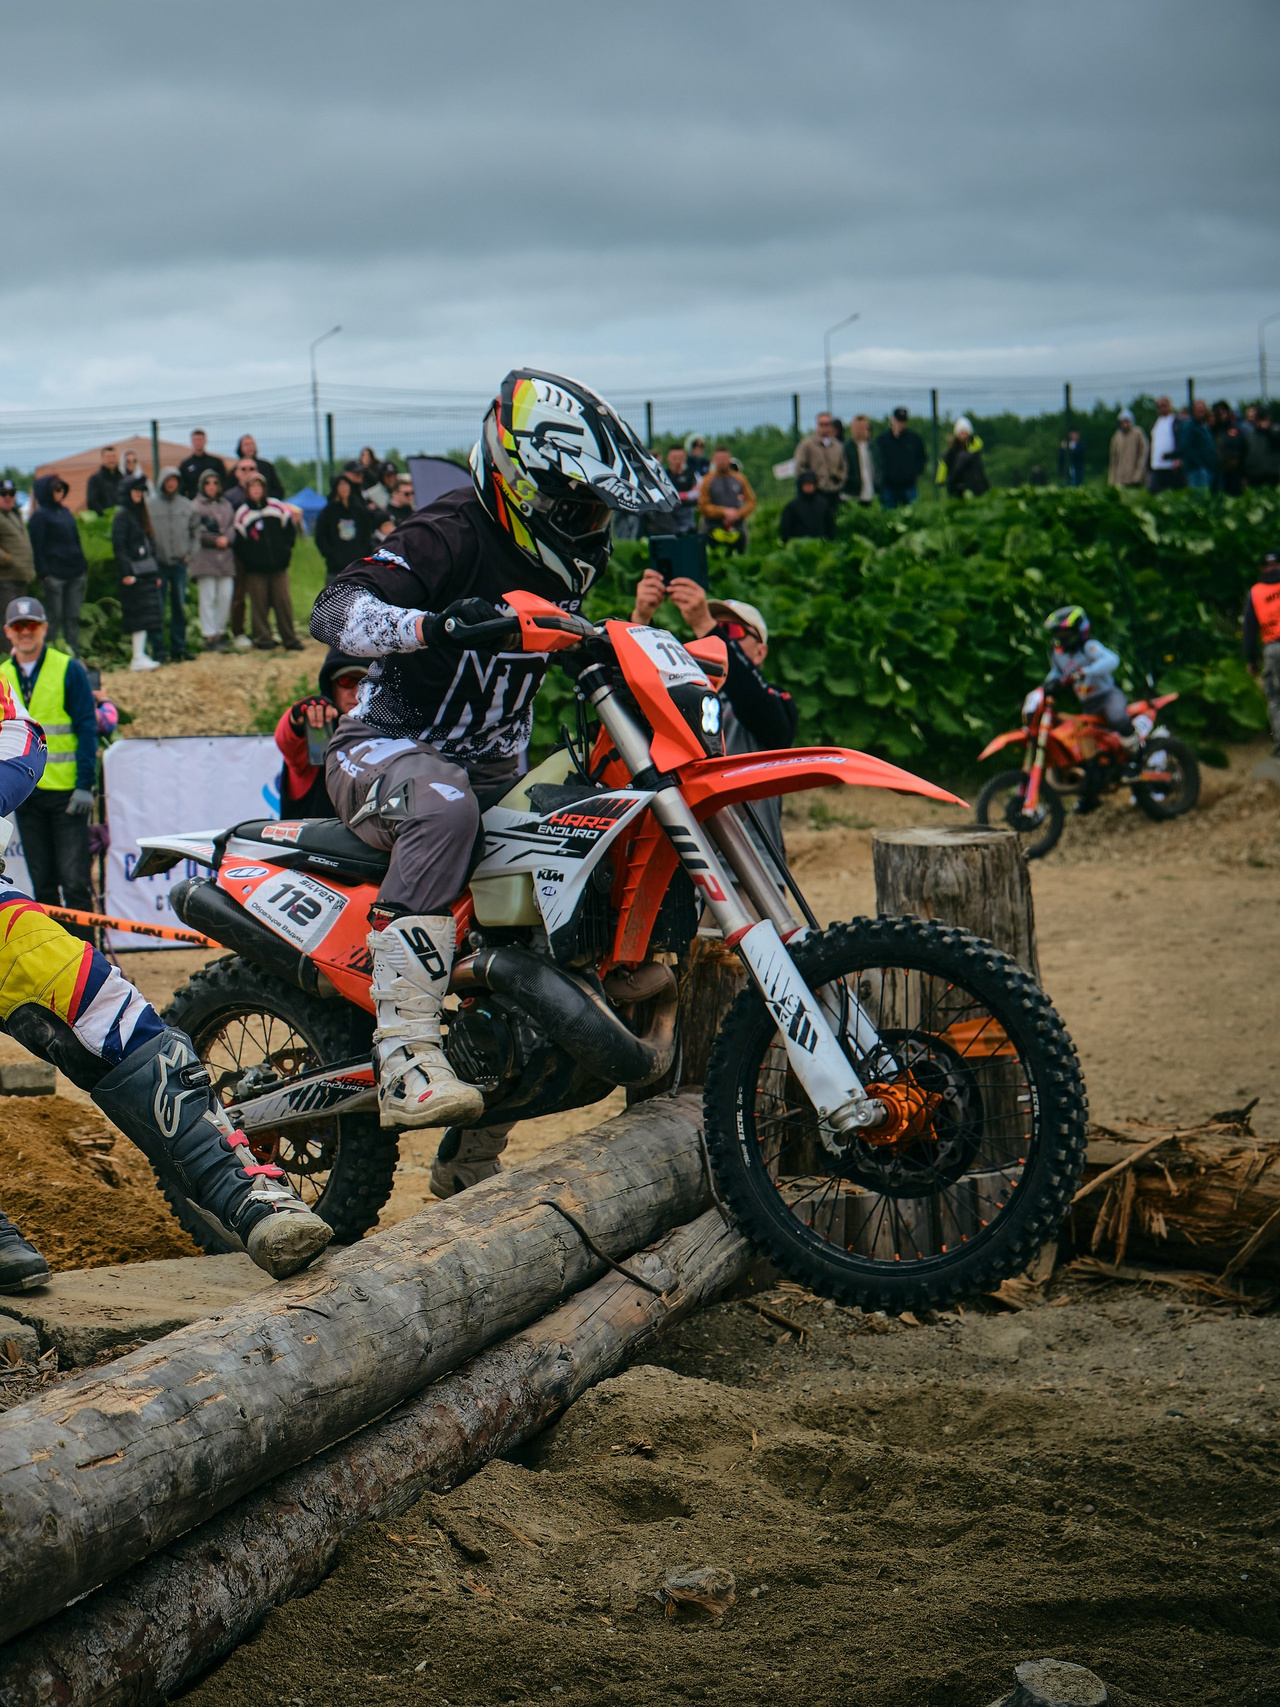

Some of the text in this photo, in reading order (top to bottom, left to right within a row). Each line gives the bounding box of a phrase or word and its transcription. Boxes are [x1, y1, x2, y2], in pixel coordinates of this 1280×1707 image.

[549, 813, 618, 829] HARD
[537, 825, 600, 839] ENDURO
[537, 868, 564, 882] KTM
[267, 883, 322, 926] 112
[252, 902, 304, 943] Образцов Вадим
[320, 1081, 365, 1092] ENDURO
